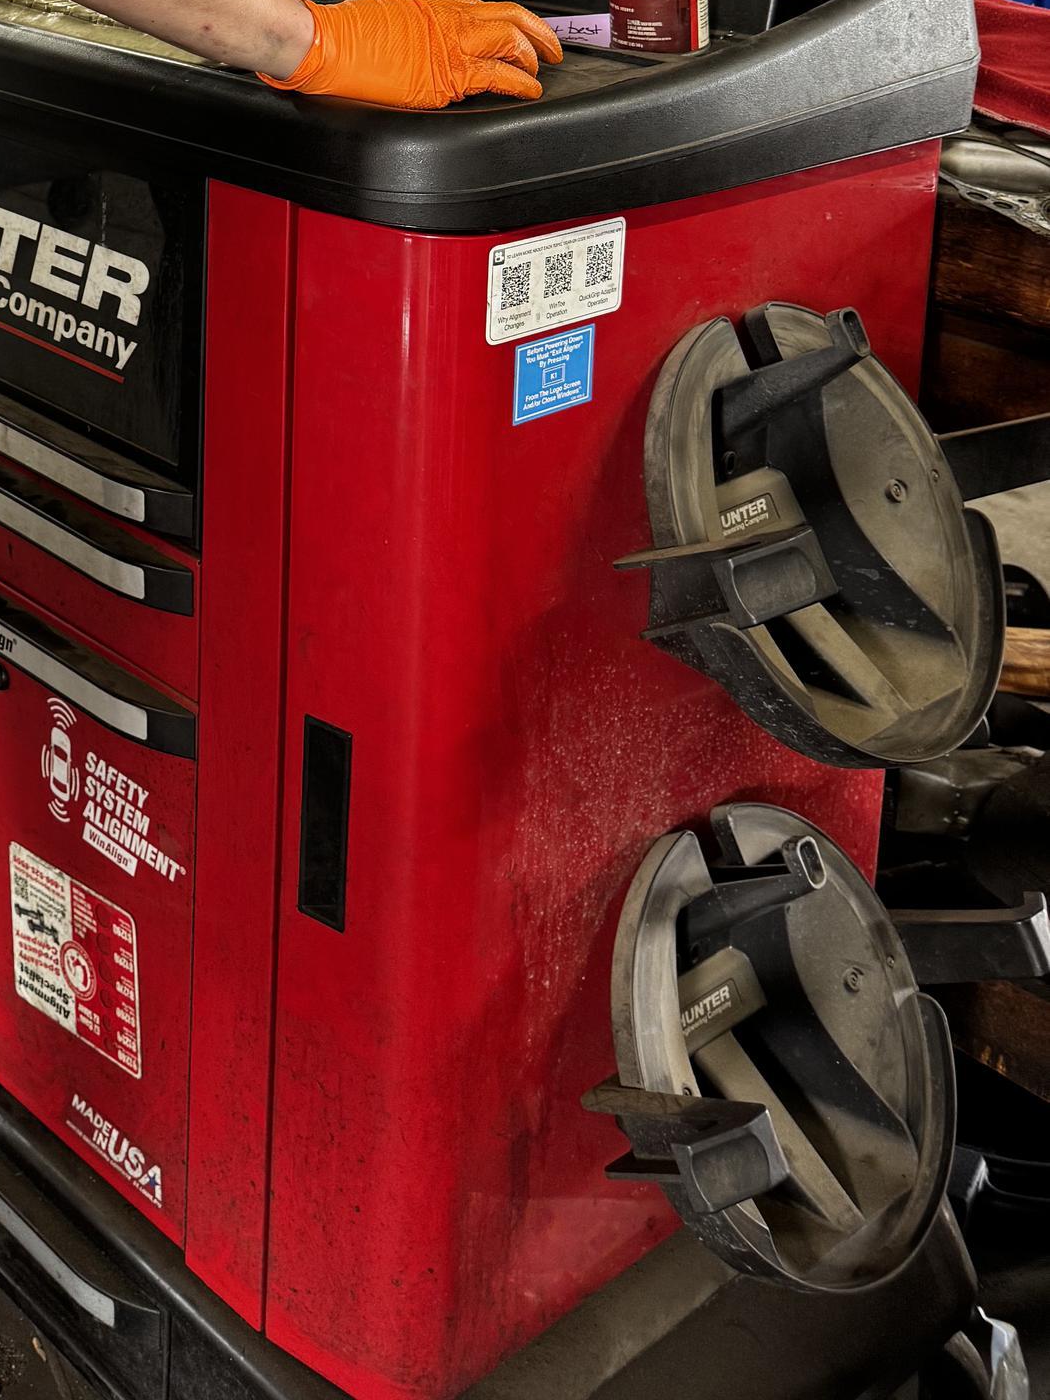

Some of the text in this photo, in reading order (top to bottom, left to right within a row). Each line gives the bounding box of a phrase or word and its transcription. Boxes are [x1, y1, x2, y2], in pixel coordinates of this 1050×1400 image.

[568, 21, 602, 36] best
[587, 297, 609, 308] Operation
[497, 310, 531, 324] Why Alignment
[546, 308, 568, 319] Operation
[504, 321, 525, 331] Changes
[526, 335, 584, 356] Before Powering Down
[525, 356, 536, 364] You
[536, 352, 550, 361] Must
[539, 354, 570, 368] By Pressing
[525, 380, 582, 402] From The Logo Screen
[541, 395, 557, 404] Close
[721, 498, 767, 528] UNTER
[85, 751, 150, 809] SAFETY
[84, 775, 150, 836] SYSTEM
[19, 962, 70, 1005] Specialist
[18, 976, 70, 1019] Alignment
[71, 1093, 112, 1137] MADE
[92, 1129, 109, 1151] IN
[108, 1127, 163, 1201] USA
